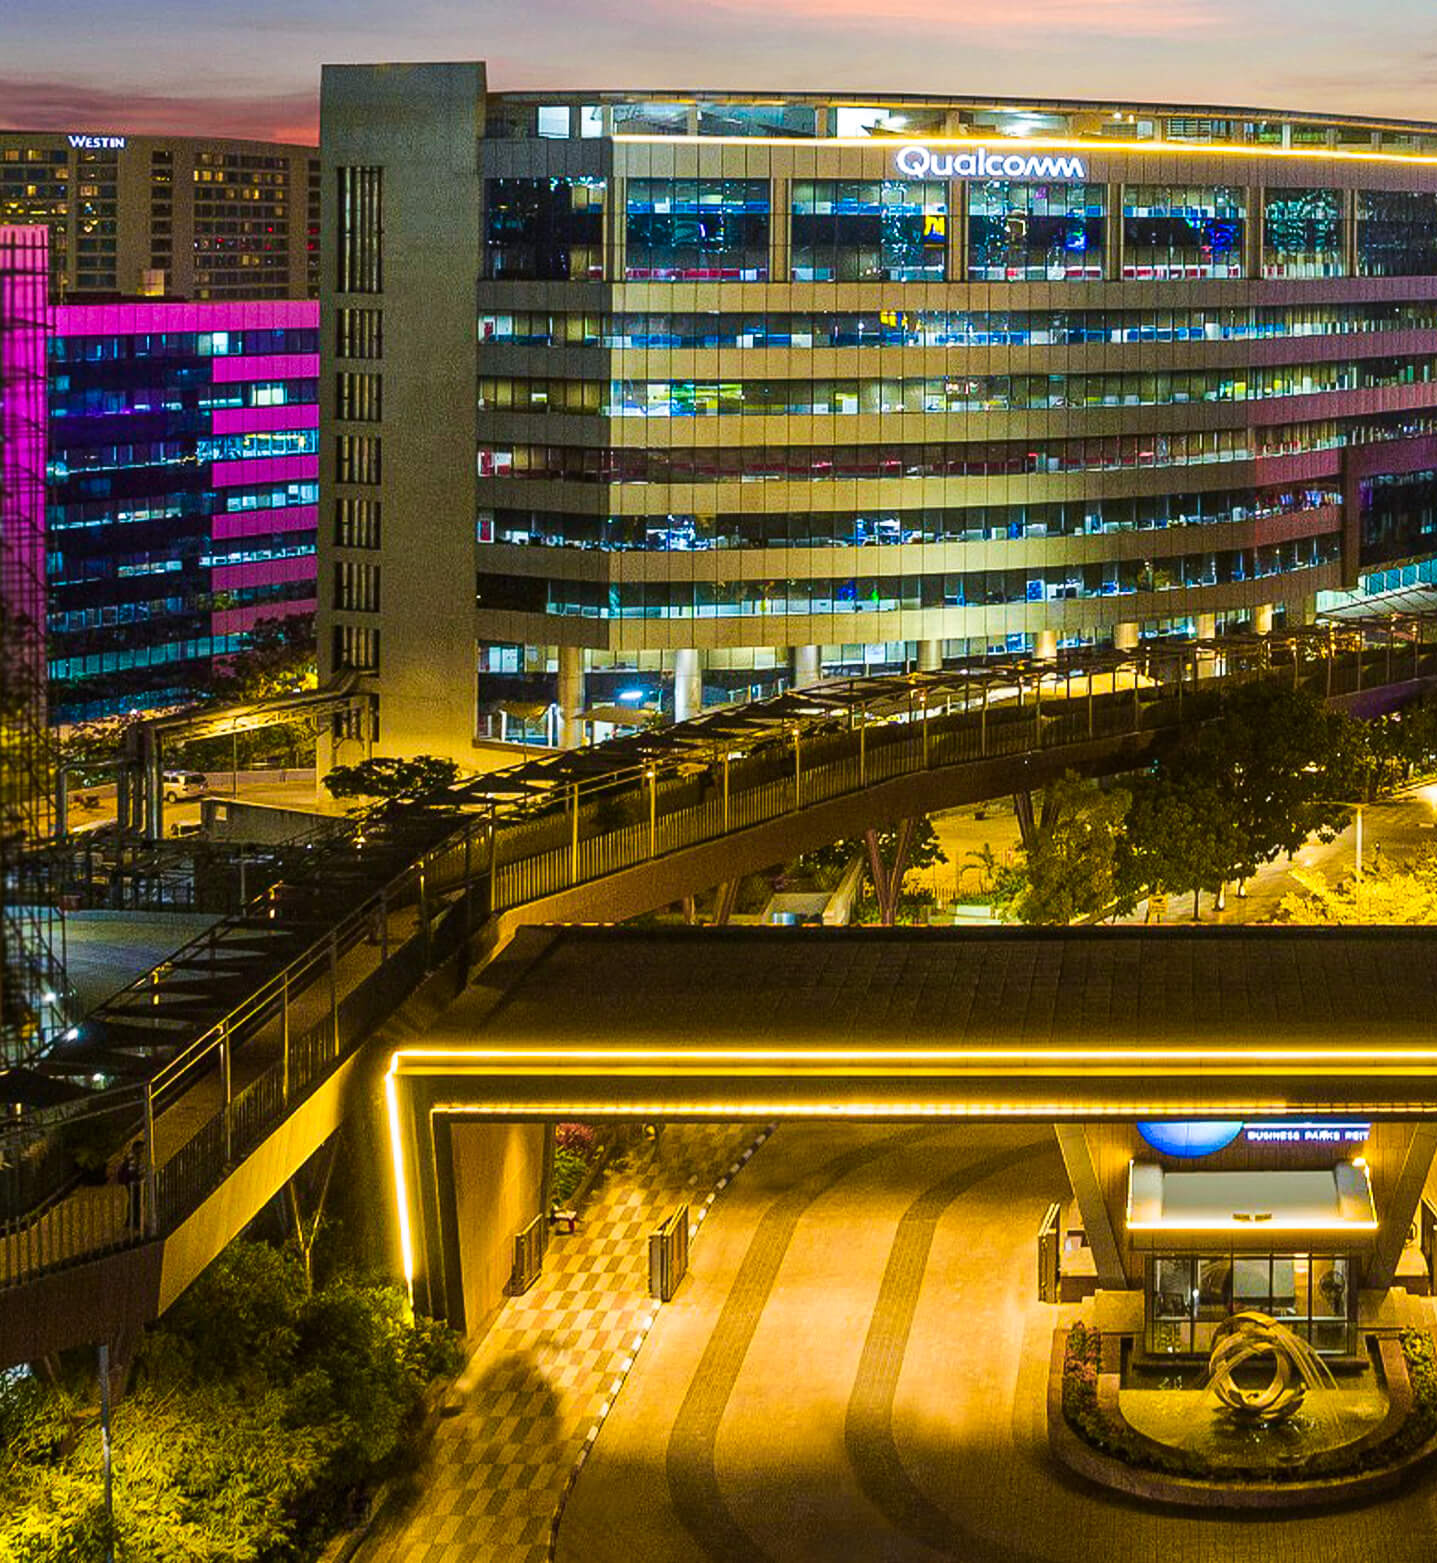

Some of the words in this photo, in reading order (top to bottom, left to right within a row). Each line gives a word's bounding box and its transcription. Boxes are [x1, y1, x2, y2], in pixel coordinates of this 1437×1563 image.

[67, 135, 125, 149] WESTIN
[896, 145, 1085, 179] Qualcomm
[1246, 1130, 1300, 1141] BUSINESS
[1304, 1129, 1341, 1141] PARKS
